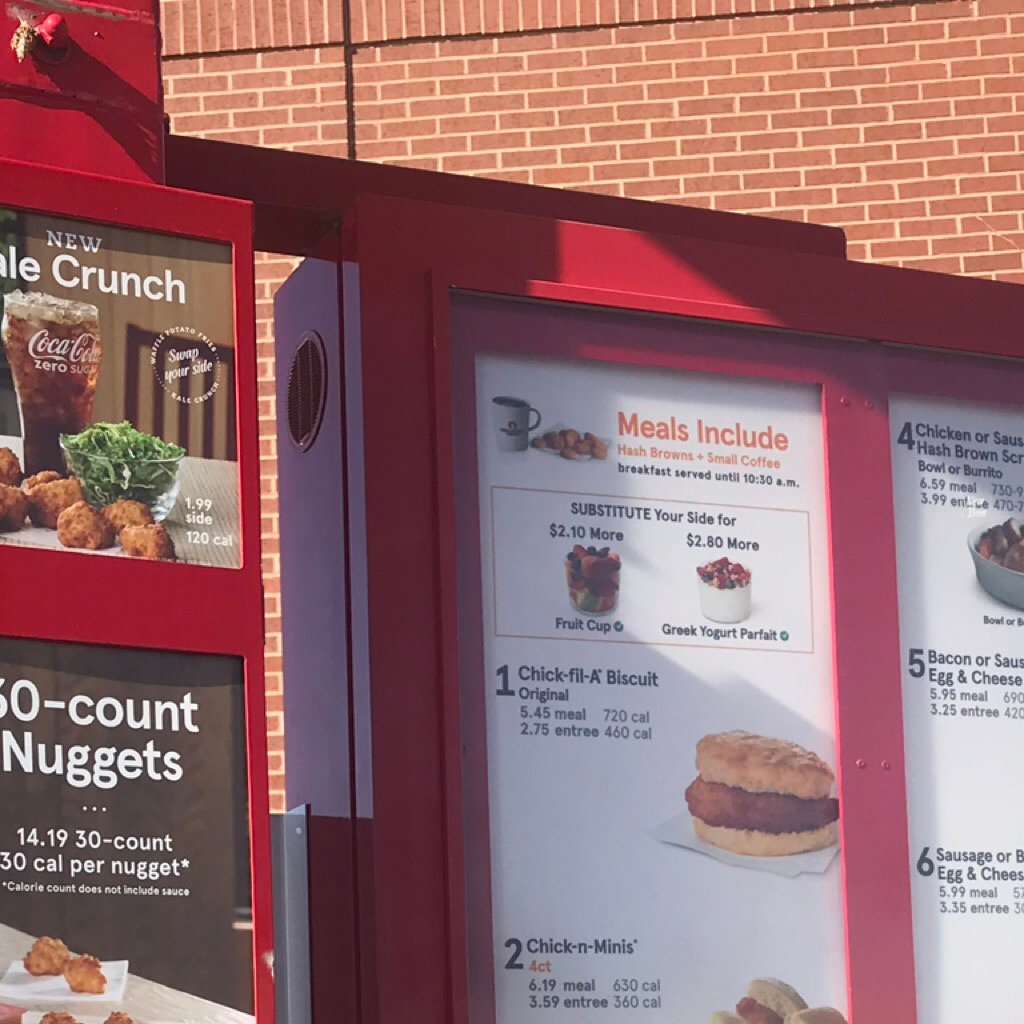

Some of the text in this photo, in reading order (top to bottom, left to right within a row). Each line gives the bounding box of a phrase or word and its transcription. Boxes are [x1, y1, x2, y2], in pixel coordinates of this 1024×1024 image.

[47, 231, 101, 253] NEW
[51, 251, 188, 304] Crunch
[168, 348, 199, 363] Swap
[164, 359, 214, 384] your side
[617, 411, 788, 451] Meals Include
[617, 444, 780, 469] Hash Browns + Small Coffee
[617, 462, 799, 487] breakfast served until 10:30 a.m.
[918, 460, 1003, 479] Bowl or Burrito
[184, 497, 212, 511] 1.99
[571, 502, 736, 526] SUBSTITUTE Your Side for
[185, 512, 212, 525] side
[186, 531, 232, 546] 120 cal
[3, 730, 183, 788] Nuggets
[17, 828, 172, 851] 14.19 30-count
[0, 852, 26, 871] 30
[33, 854, 62, 872] cal
[71, 860, 104, 877] per
[47, 884, 76, 892] count
[79, 884, 102, 893] does
[105, 886, 121, 894] not
[124, 885, 159, 895] include
[162, 888, 189, 896] sauce
